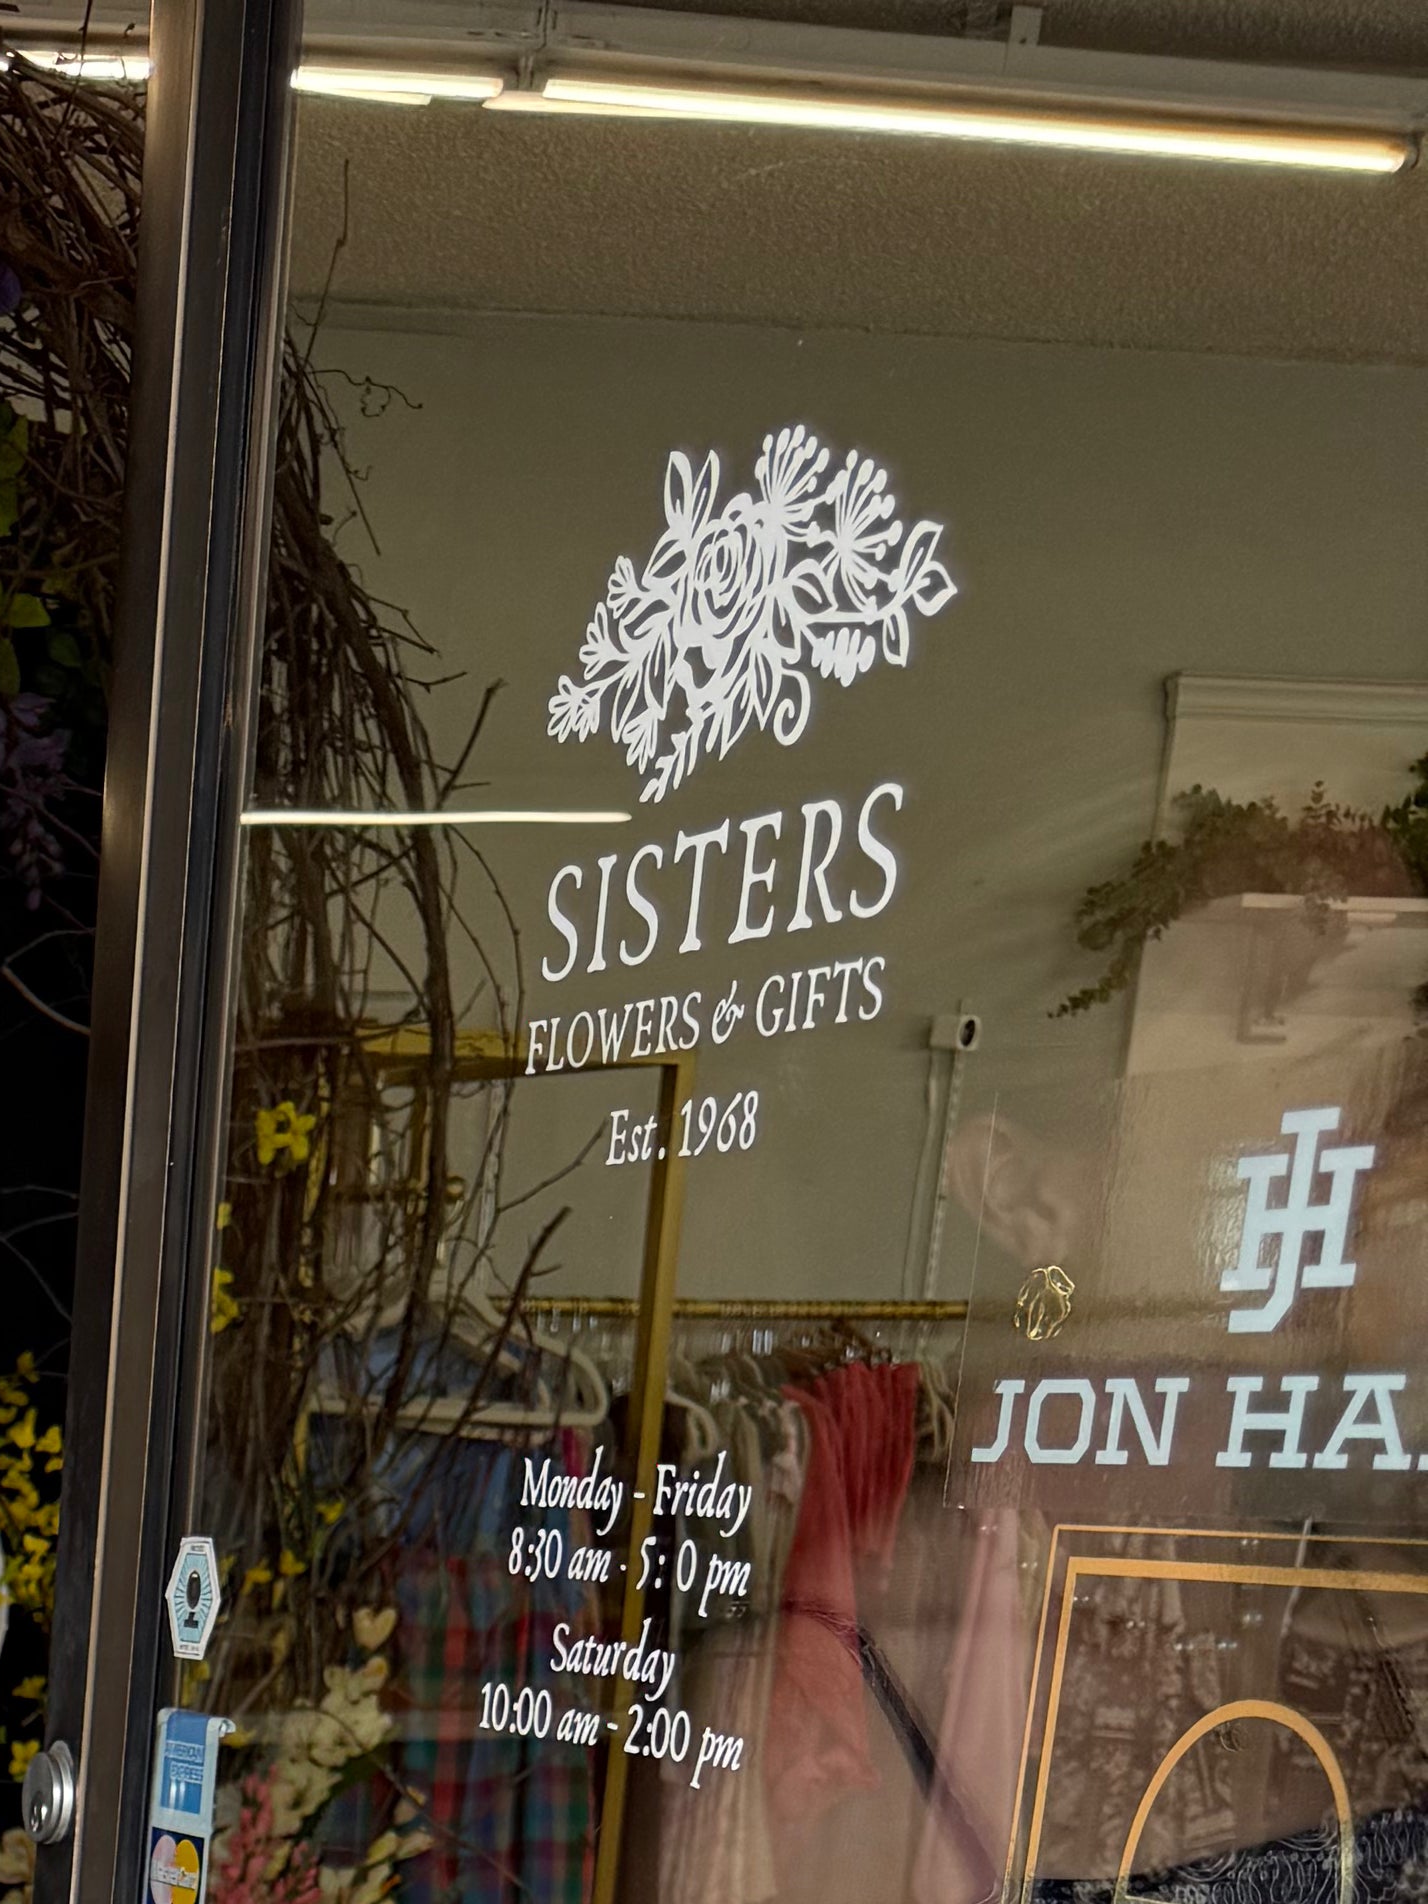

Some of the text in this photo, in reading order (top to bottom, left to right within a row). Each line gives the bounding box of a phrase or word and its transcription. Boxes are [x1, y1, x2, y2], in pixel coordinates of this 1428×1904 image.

[541, 783, 904, 983] SISTERS
[525, 956, 886, 1075] FLOWERS & GIFTS
[605, 1090, 759, 1166] Est. 1968
[971, 1375, 1428, 1470] JON HA
[520, 1445, 623, 1536] Monday
[653, 1450, 752, 1537] Friday
[508, 1527, 563, 1582] 8:30
[567, 1546, 612, 1583] am
[698, 1554, 751, 1618] pm
[550, 1617, 675, 1701] Saturday
[479, 1682, 552, 1738] 10:00
[556, 1708, 600, 1745] am
[624, 1704, 690, 1762] 2:00
[690, 1727, 744, 1789] pm
